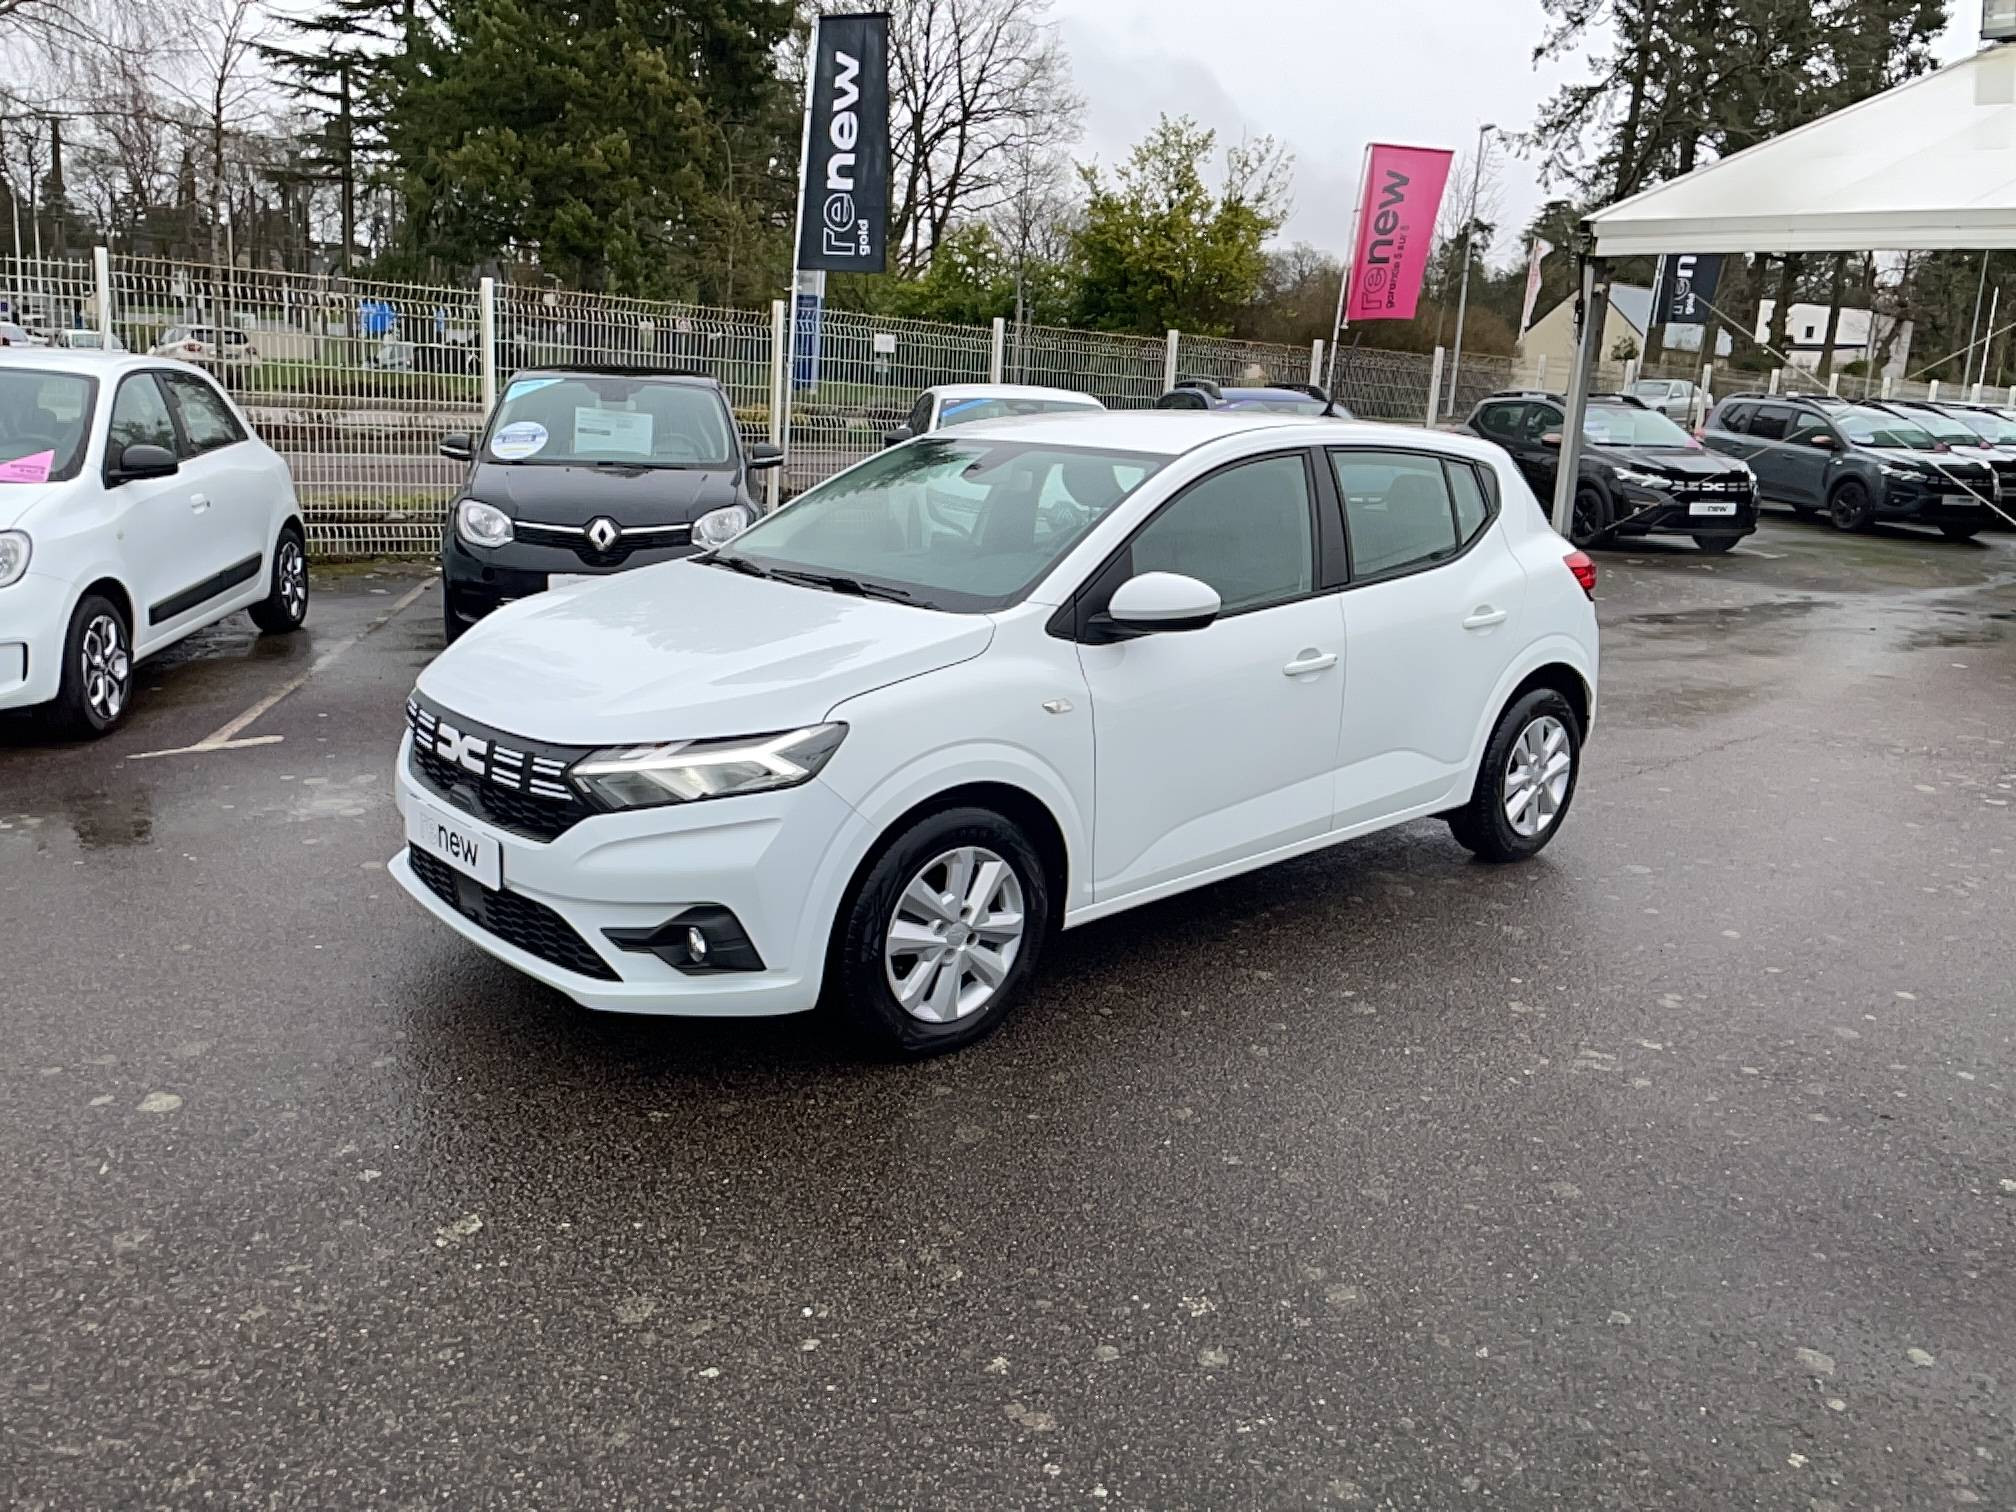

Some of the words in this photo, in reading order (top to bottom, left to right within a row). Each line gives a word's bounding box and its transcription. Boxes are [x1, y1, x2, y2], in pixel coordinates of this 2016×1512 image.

[823, 51, 859, 256] renew
[857, 219, 871, 256] gold
[1361, 170, 1409, 310] renew
